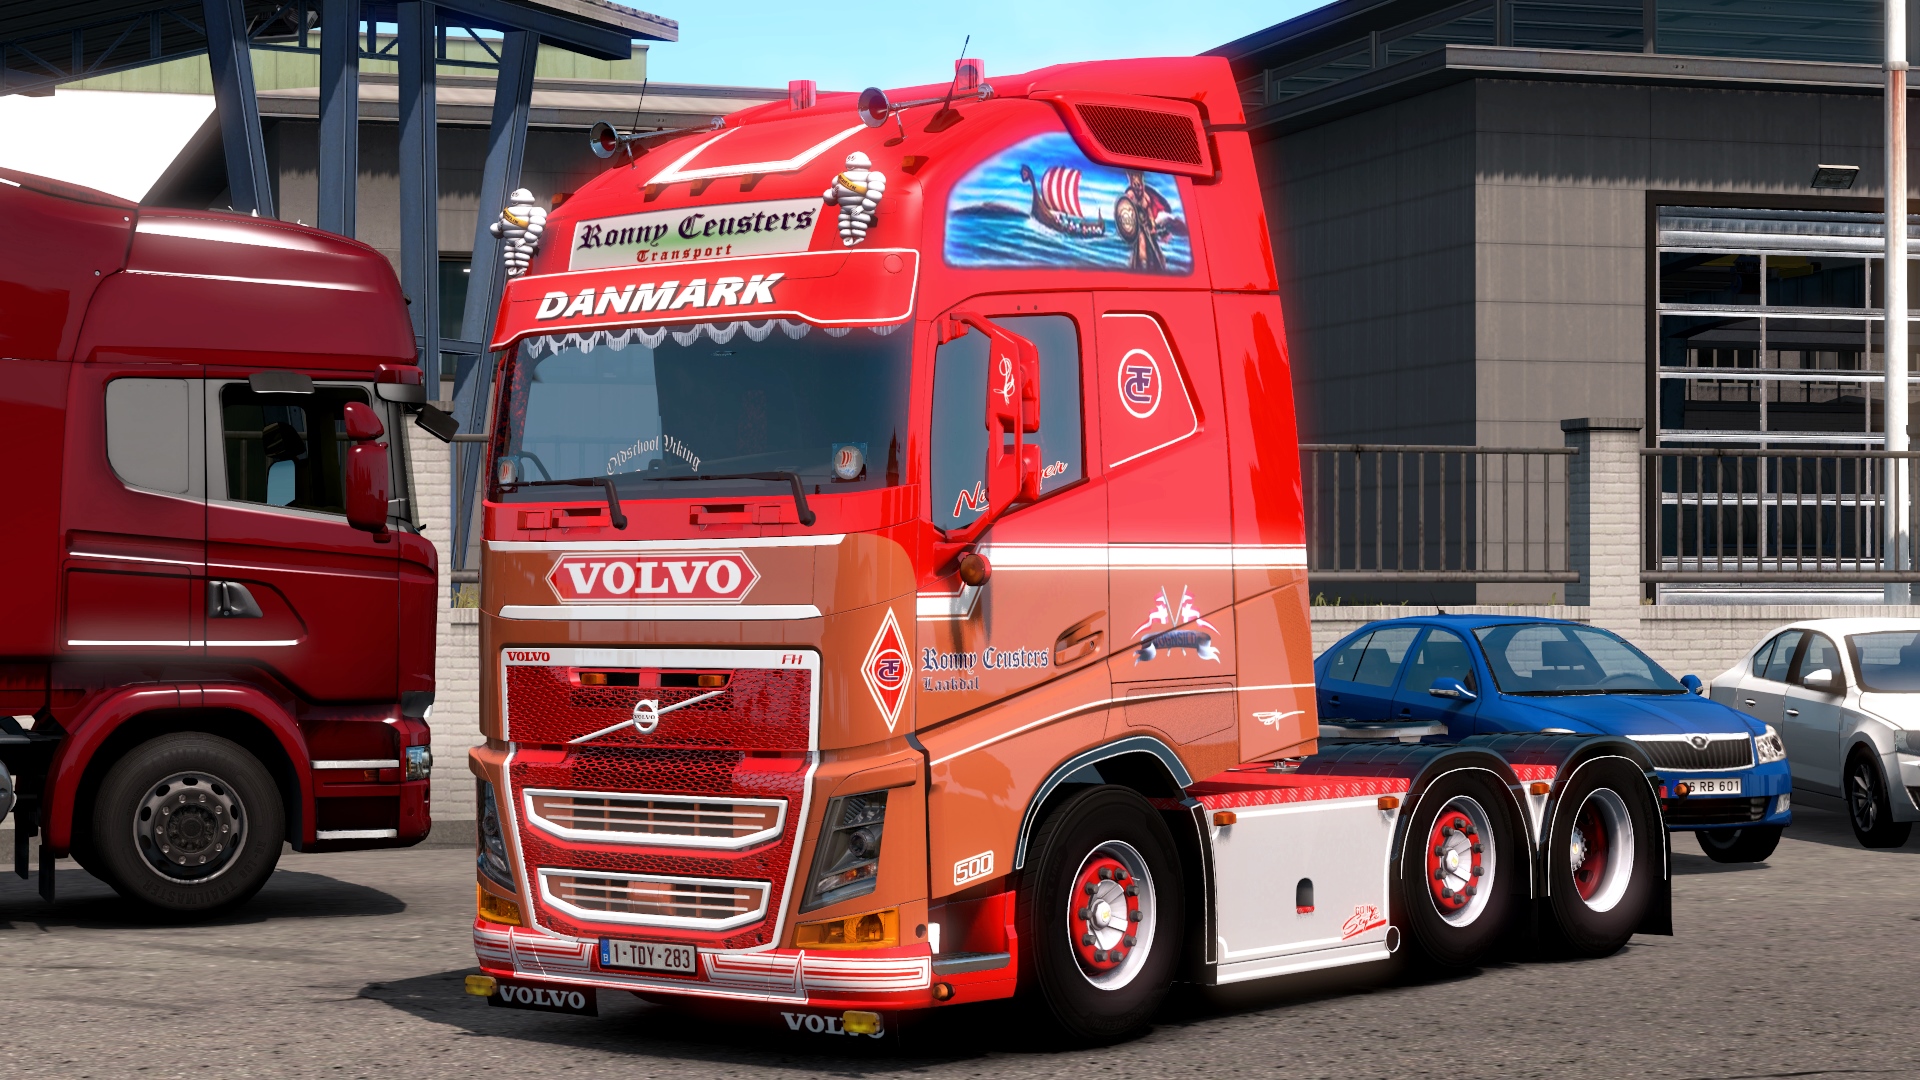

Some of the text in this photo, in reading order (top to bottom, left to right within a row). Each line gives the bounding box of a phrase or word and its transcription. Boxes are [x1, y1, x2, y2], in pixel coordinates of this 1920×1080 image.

[577, 208, 816, 251] Ronny Ceusters
[636, 244, 732, 263] Transport
[535, 272, 786, 321] DANMARK
[606, 434, 702, 476] Oldschool Viking
[563, 559, 742, 595] VOLVO
[506, 651, 551, 662] VOLVO
[781, 654, 803, 665] FH
[921, 645, 1049, 675] Ronny Ceusters
[922, 676, 979, 692] Laakdal
[1699, 781, 1715, 792] RB
[1719, 780, 1740, 792] 601
[957, 855, 992, 882] 500
[500, 985, 586, 1009] VOLVO
[780, 1012, 885, 1039] VOL
